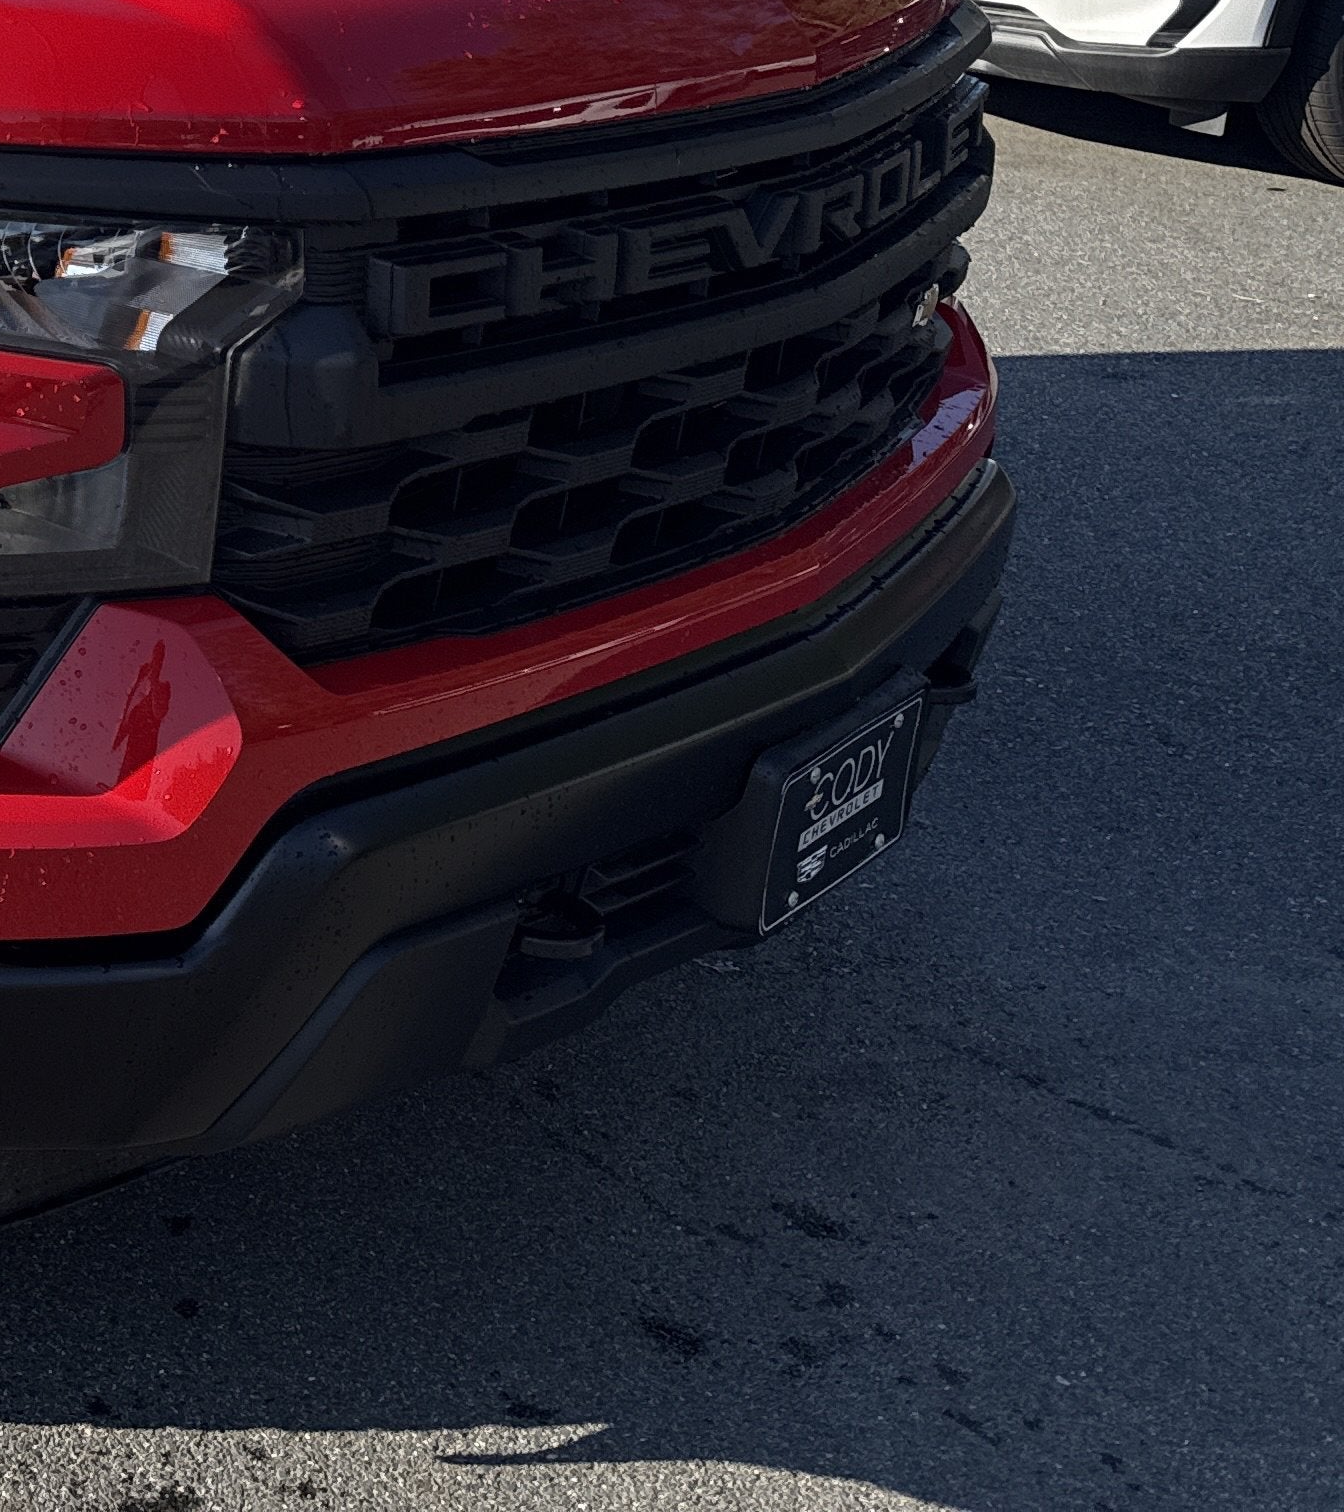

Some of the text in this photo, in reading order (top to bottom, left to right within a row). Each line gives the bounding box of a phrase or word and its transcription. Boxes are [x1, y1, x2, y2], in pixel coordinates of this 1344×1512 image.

[371, 90, 987, 338] CHEVROLET
[805, 730, 895, 821] CODY
[802, 785, 881, 847] CHEVROLET
[829, 816, 879, 859] CADILLAC
